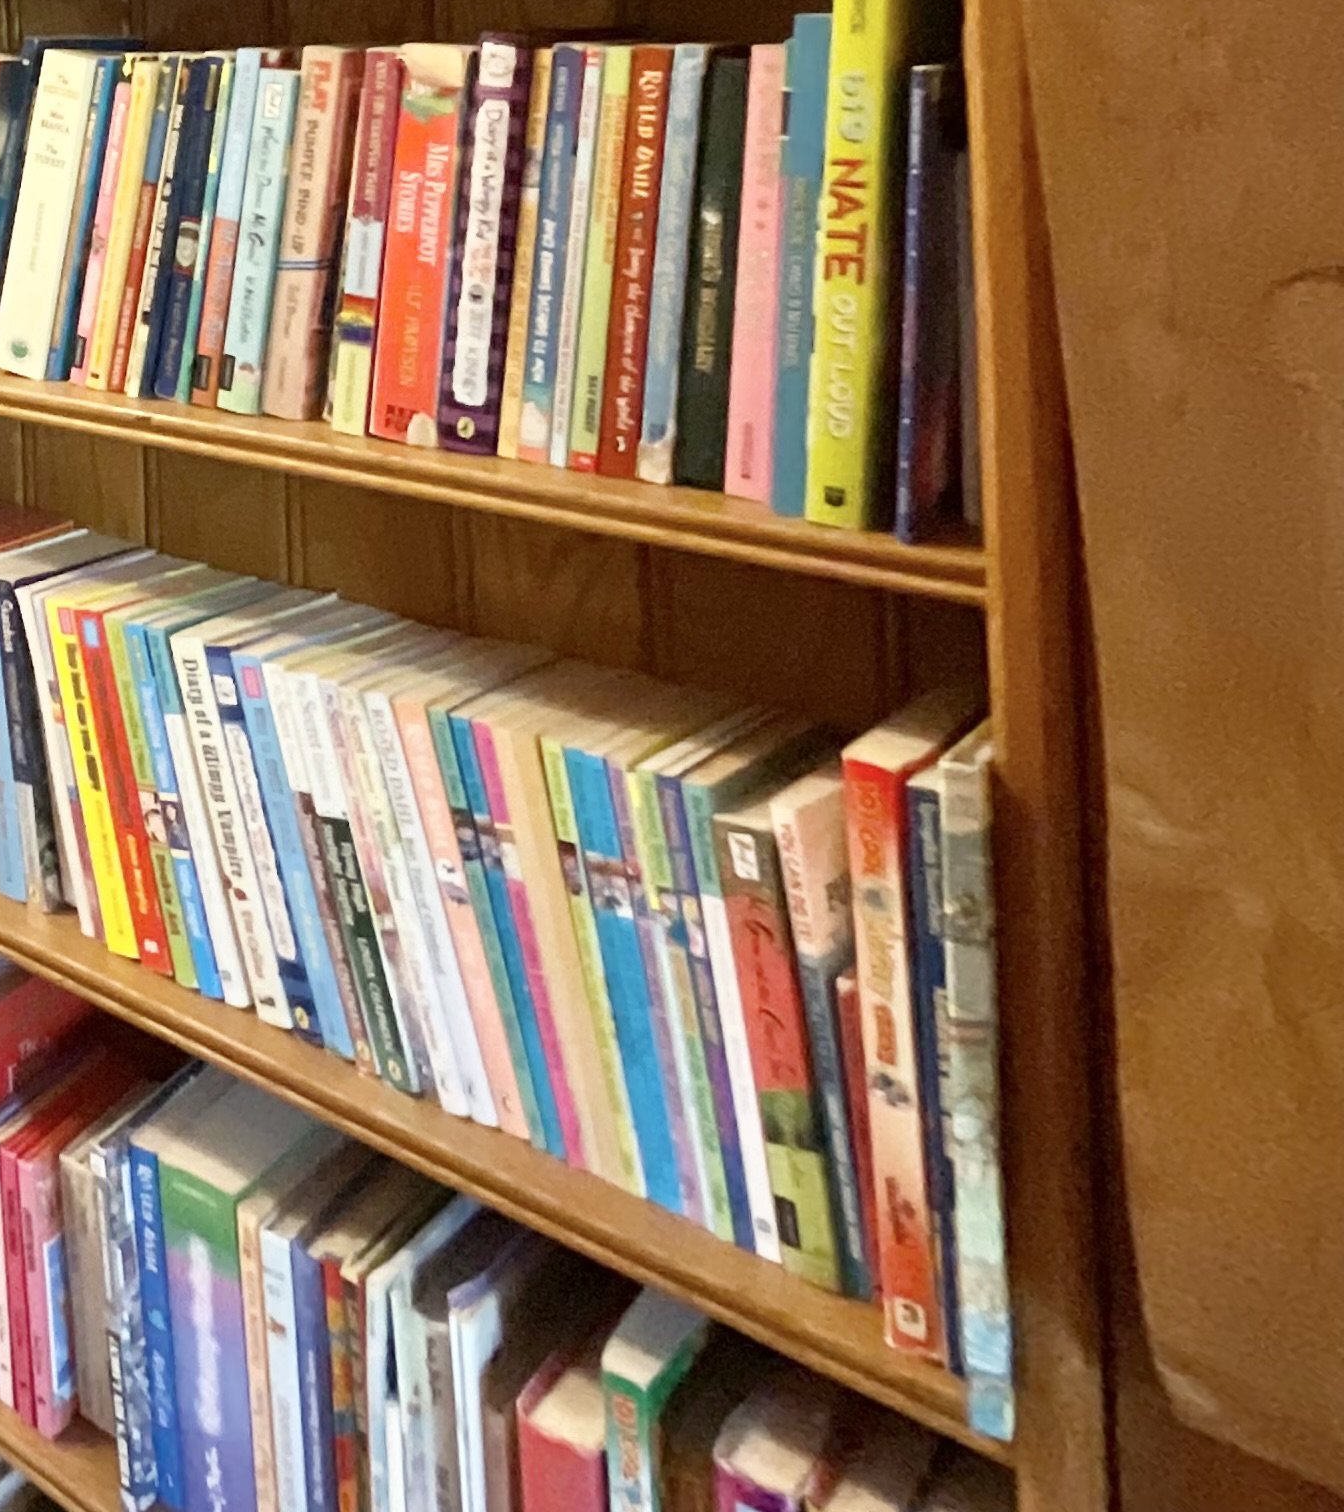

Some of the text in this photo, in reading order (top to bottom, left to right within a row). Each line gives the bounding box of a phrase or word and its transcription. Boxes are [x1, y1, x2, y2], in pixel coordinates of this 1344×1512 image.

[395, 171, 421, 233] STORIES
[417, 179, 445, 268] PEPPERPOT
[825, 157, 868, 439] NATE OUT LOUD
[182, 658, 206, 706] Diary
[216, 809, 245, 878] Vampire
[366, 982, 395, 1054] CHAPMAN
